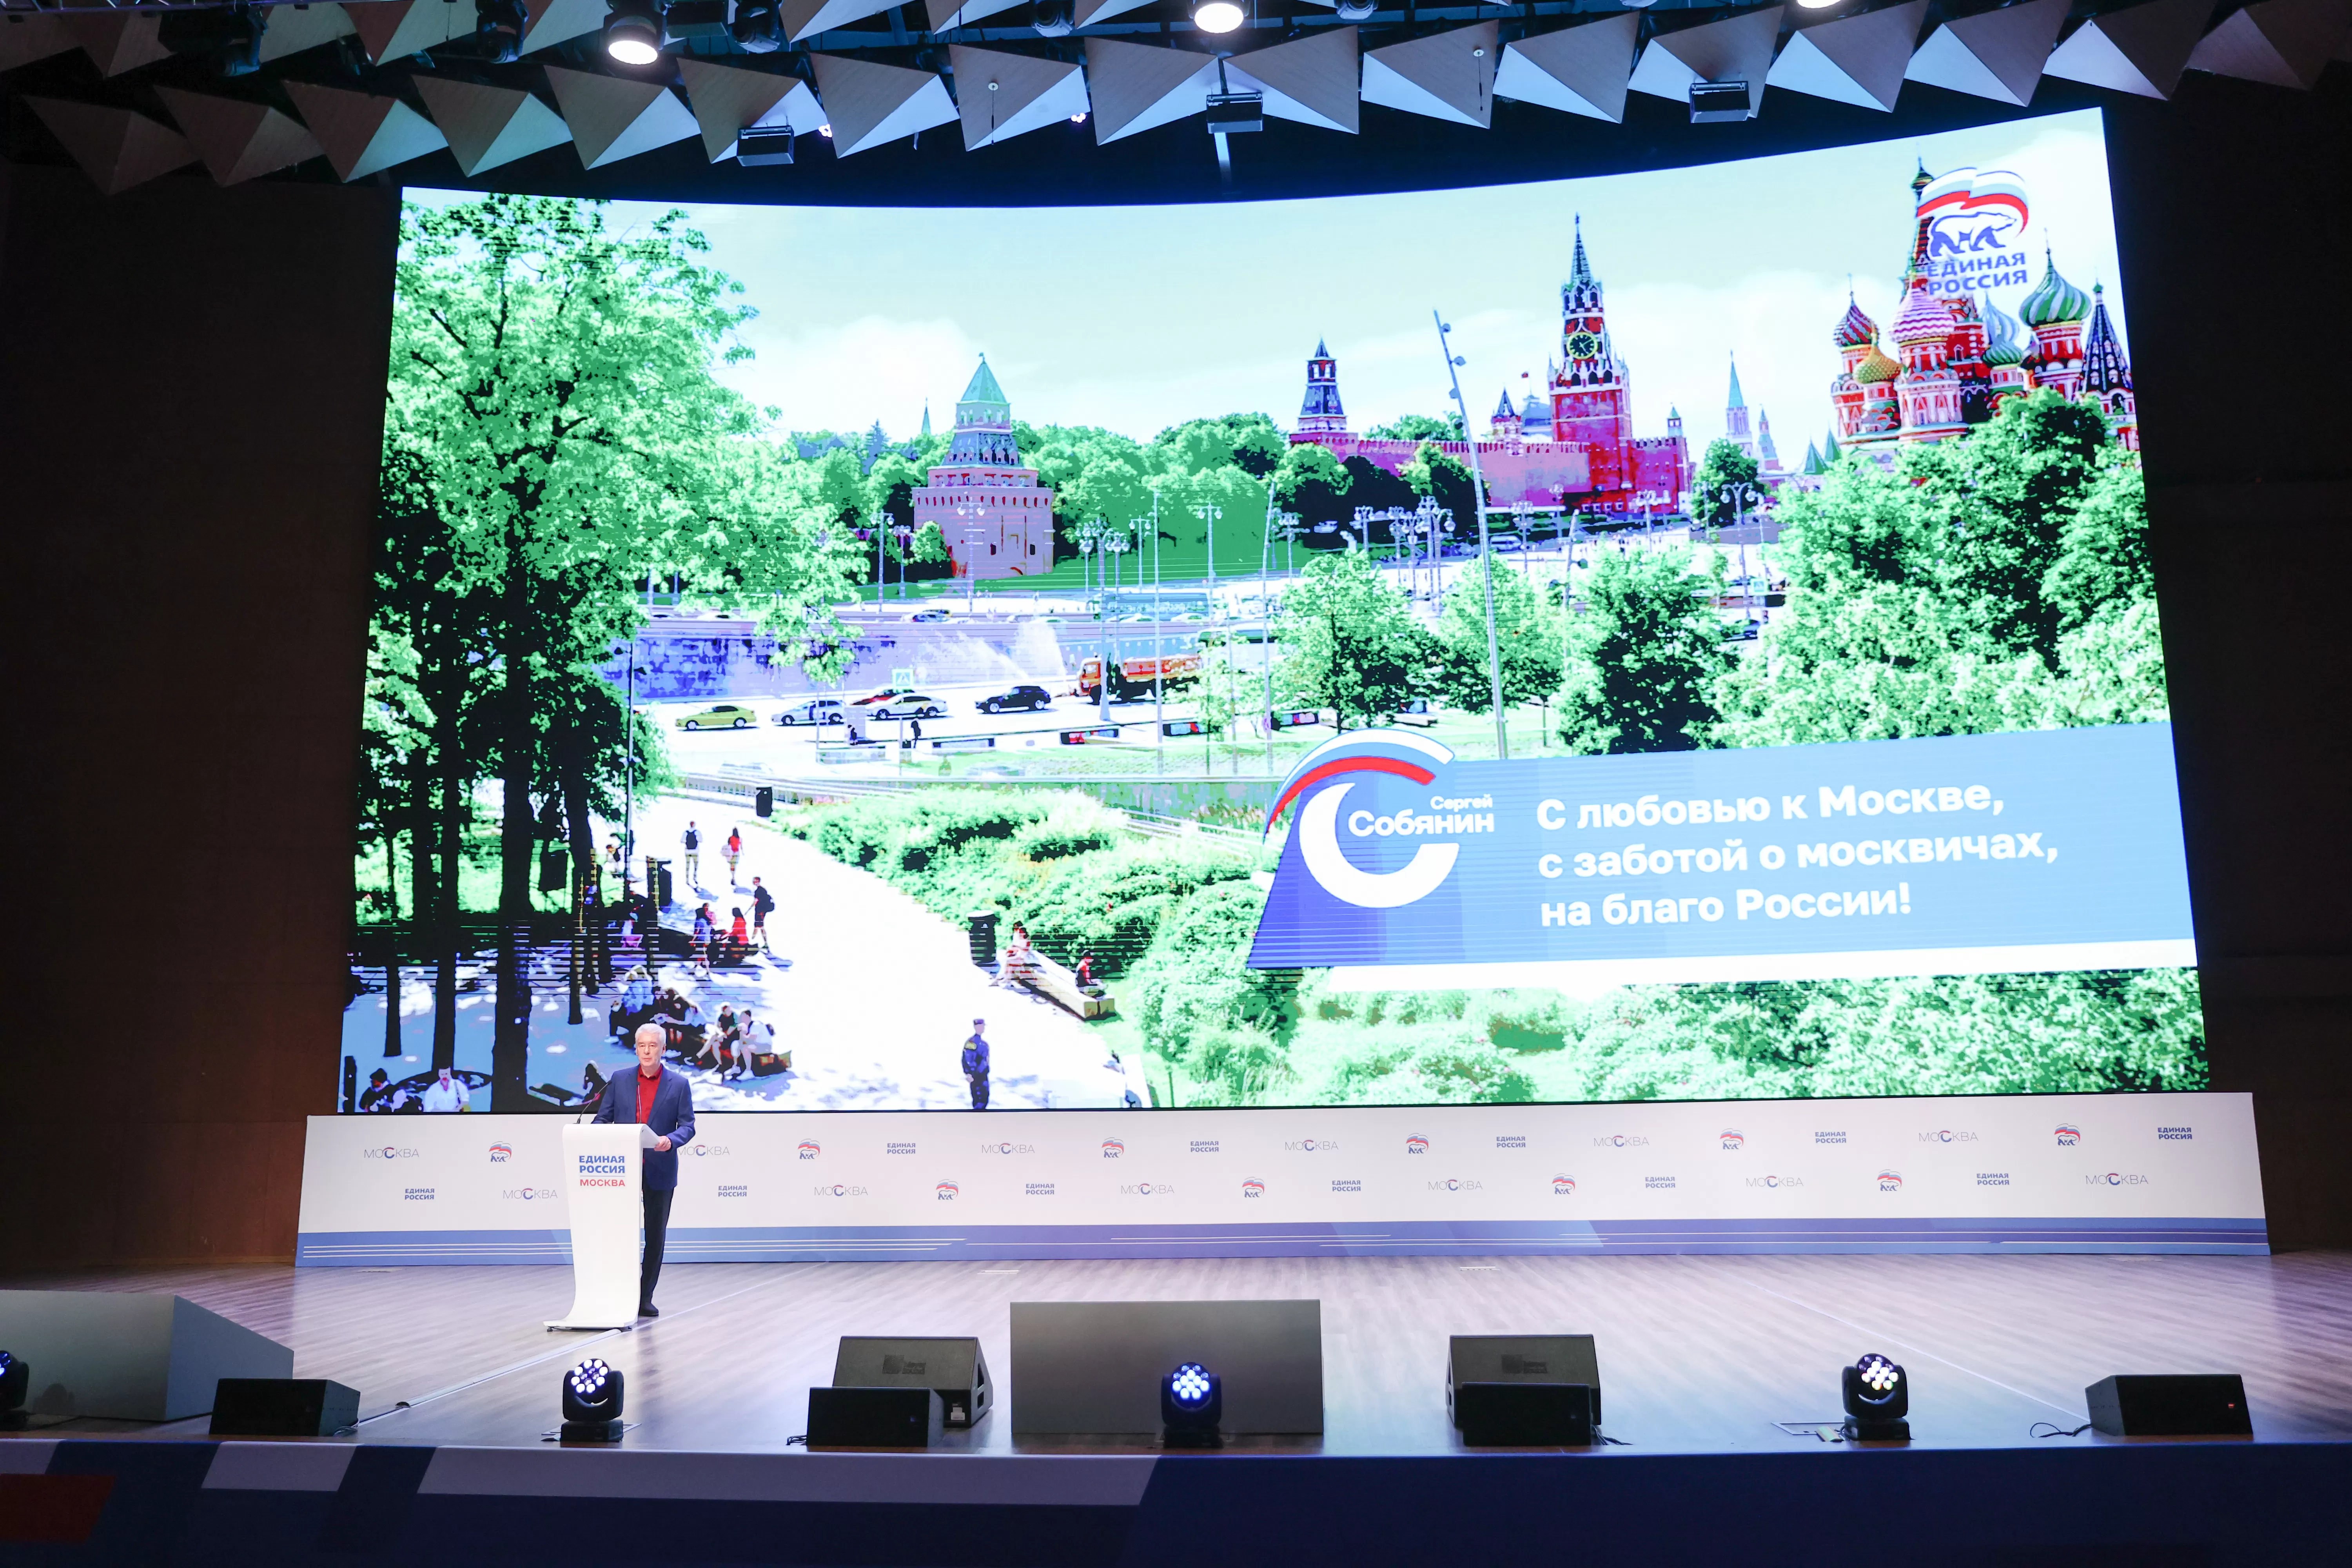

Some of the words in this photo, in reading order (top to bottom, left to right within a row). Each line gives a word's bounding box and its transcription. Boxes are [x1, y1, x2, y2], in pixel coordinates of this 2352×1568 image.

[1927, 252, 2026, 278] ЕДИНАЯ
[1928, 269, 2028, 295] РОССИЯ
[1430, 794, 1493, 812] Сергей
[1537, 799, 1566, 830] С
[1577, 794, 1771, 829] любовью
[1782, 795, 1808, 820] к
[1818, 784, 2004, 818] Москве,
[1348, 808, 1495, 837] Собянин
[1539, 854, 1563, 878] с
[1573, 838, 1748, 877] заботой
[1759, 845, 1786, 870] о
[1797, 832, 2058, 868] москвичах,
[1541, 901, 1592, 927] на
[1602, 893, 1724, 925] благо
[1736, 882, 1912, 920] России!
[1593, 1135, 1649, 1147] МОСКВА
[1919, 1130, 1978, 1143] МОСКВА
[982, 1143, 1035, 1154] МОСКВА
[1285, 1139, 1338, 1151] МОСКВА
[364, 1147, 419, 1159] МОСКВА
[579, 1155, 624, 1164] ЕДИНАЯ
[579, 1165, 625, 1173] РОССИЯ
[1428, 1179, 1483, 1191] МОСКВА
[1746, 1175, 1804, 1188] МОСКВА
[2085, 1172, 2149, 1186] МОСКВА
[503, 1188, 557, 1200] МОСКВА
[814, 1185, 868, 1197] МОСКВА
[1121, 1183, 1174, 1195] МОСКВА
